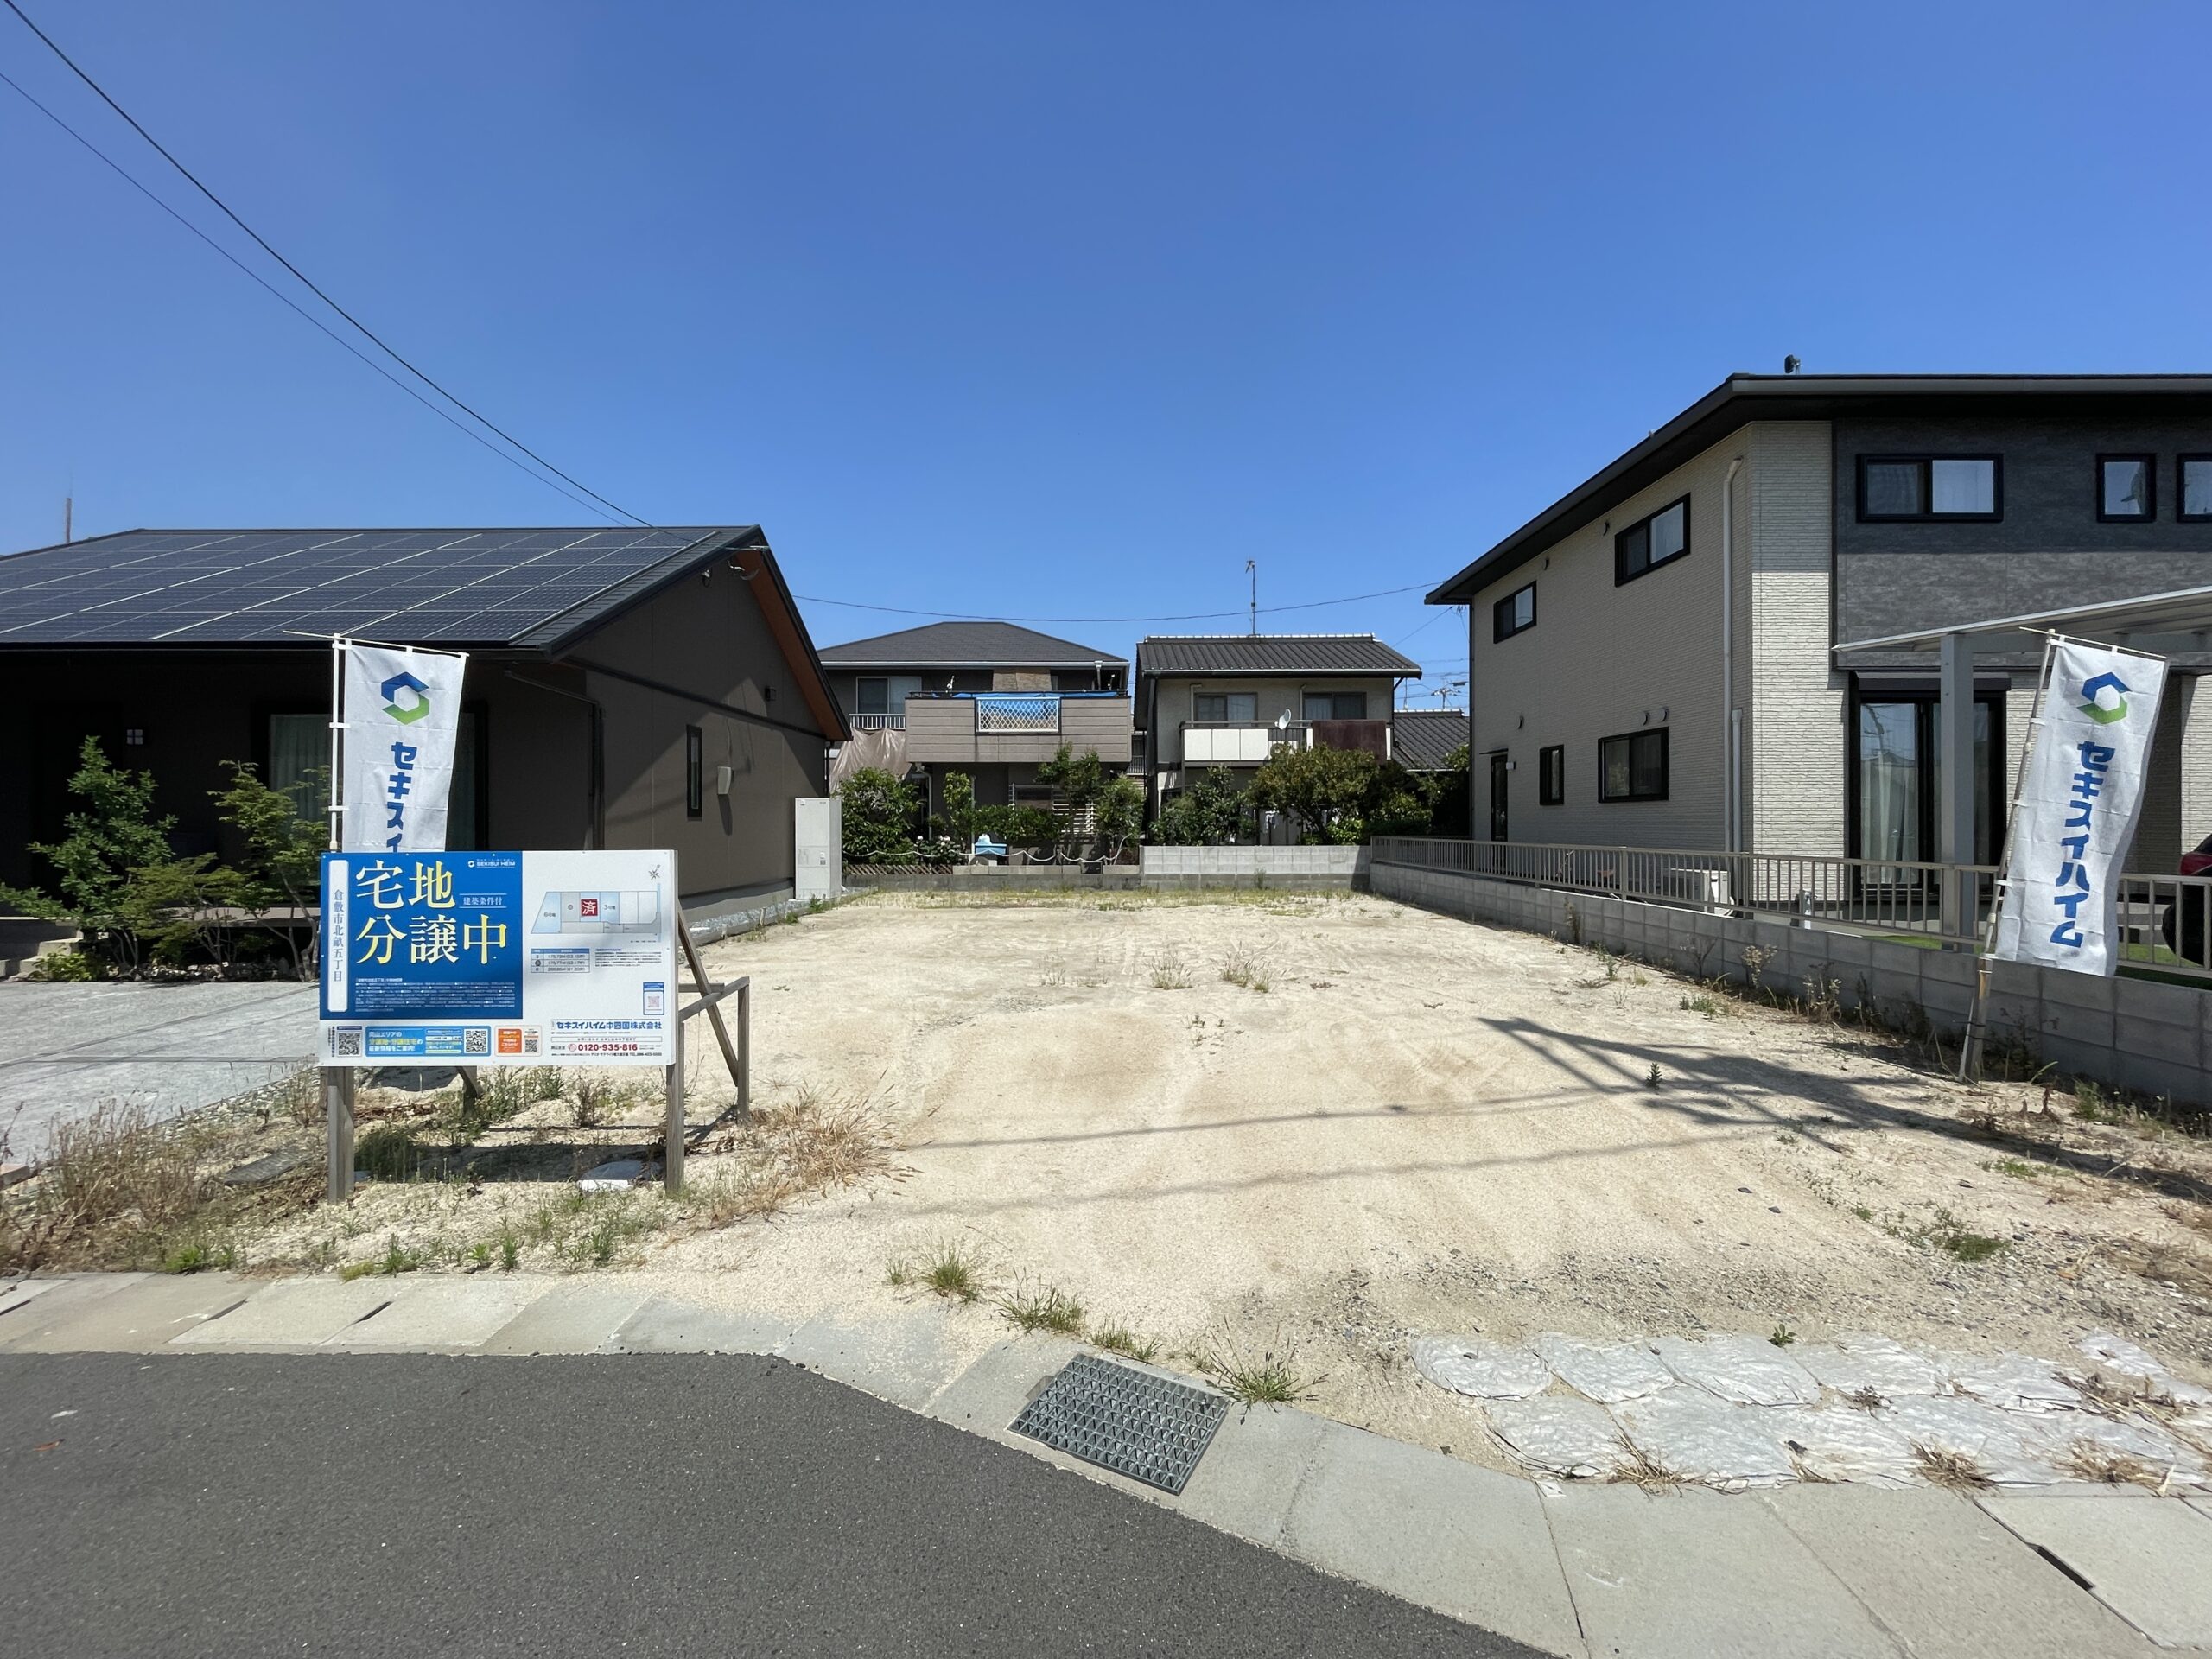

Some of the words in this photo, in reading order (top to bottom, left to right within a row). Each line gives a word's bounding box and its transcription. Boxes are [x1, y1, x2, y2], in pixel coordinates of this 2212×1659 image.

[2050, 741, 2116, 948] セキスイハイム
[355, 860, 456, 909] 宅地
[463, 896, 503, 906] 建築条件付
[582, 899, 597, 916] 済
[333, 888, 345, 982] 倉敷市北畝五丁目
[355, 914, 507, 965] 分譲中
[556, 1021, 663, 1030] セキスイハイム中四国株式会社
[577, 1043, 638, 1052] 0120-935-816
